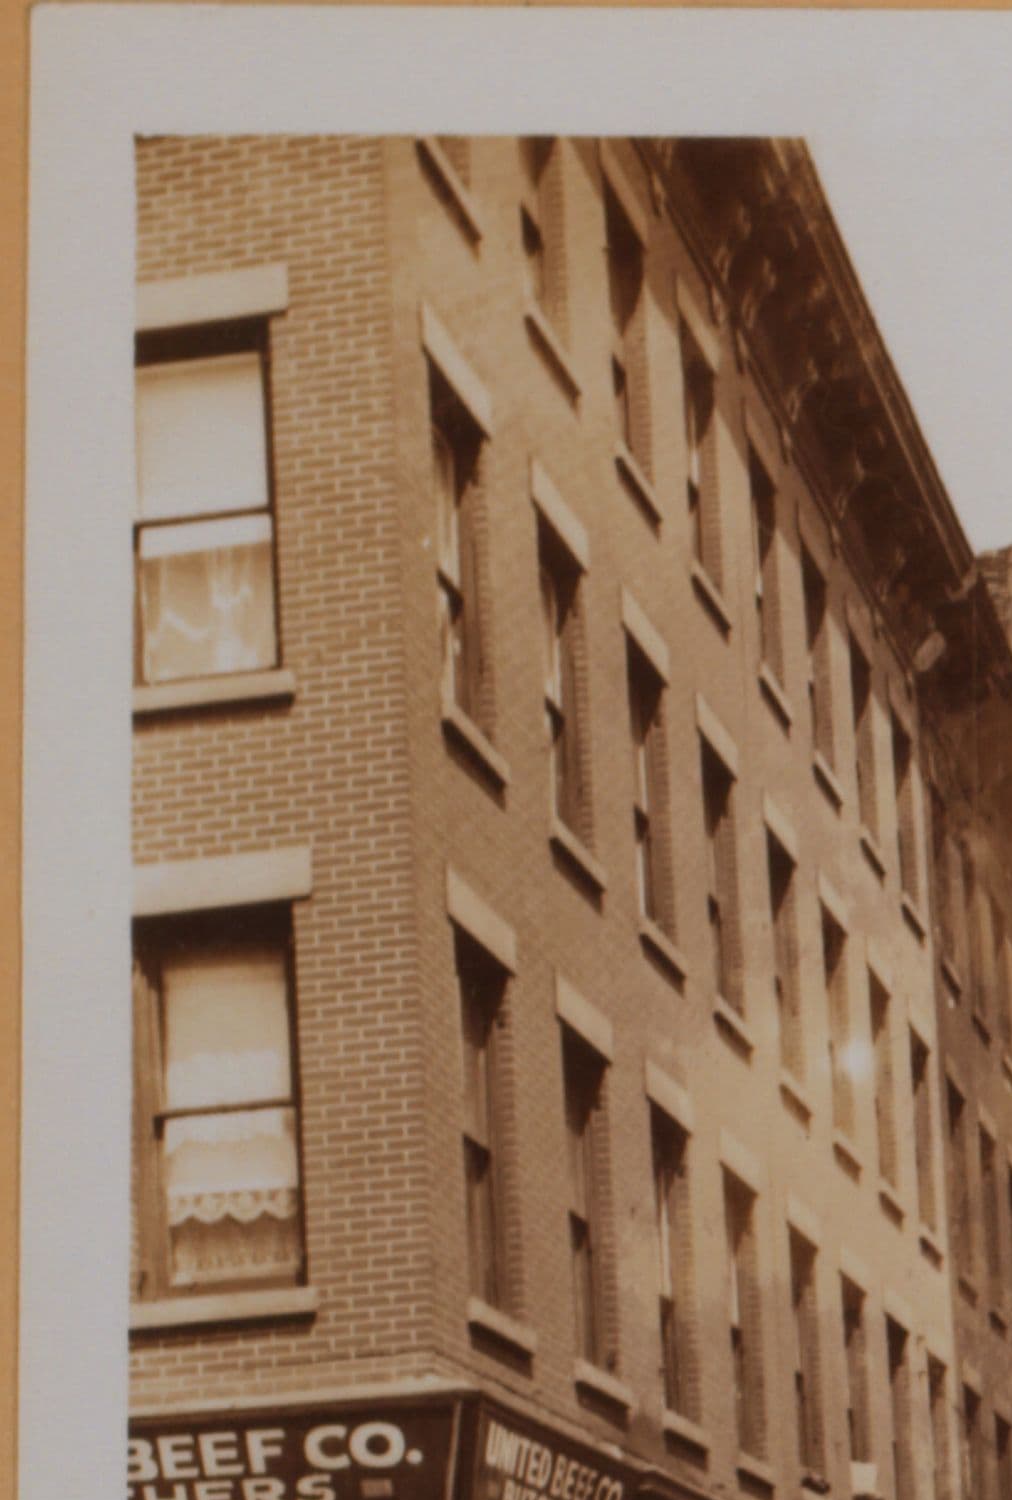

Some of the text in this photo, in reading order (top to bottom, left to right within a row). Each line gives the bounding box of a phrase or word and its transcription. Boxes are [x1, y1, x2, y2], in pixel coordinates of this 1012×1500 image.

[128, 1421, 424, 1482] BEEF CO.
[485, 1420, 552, 1490] UNITED
